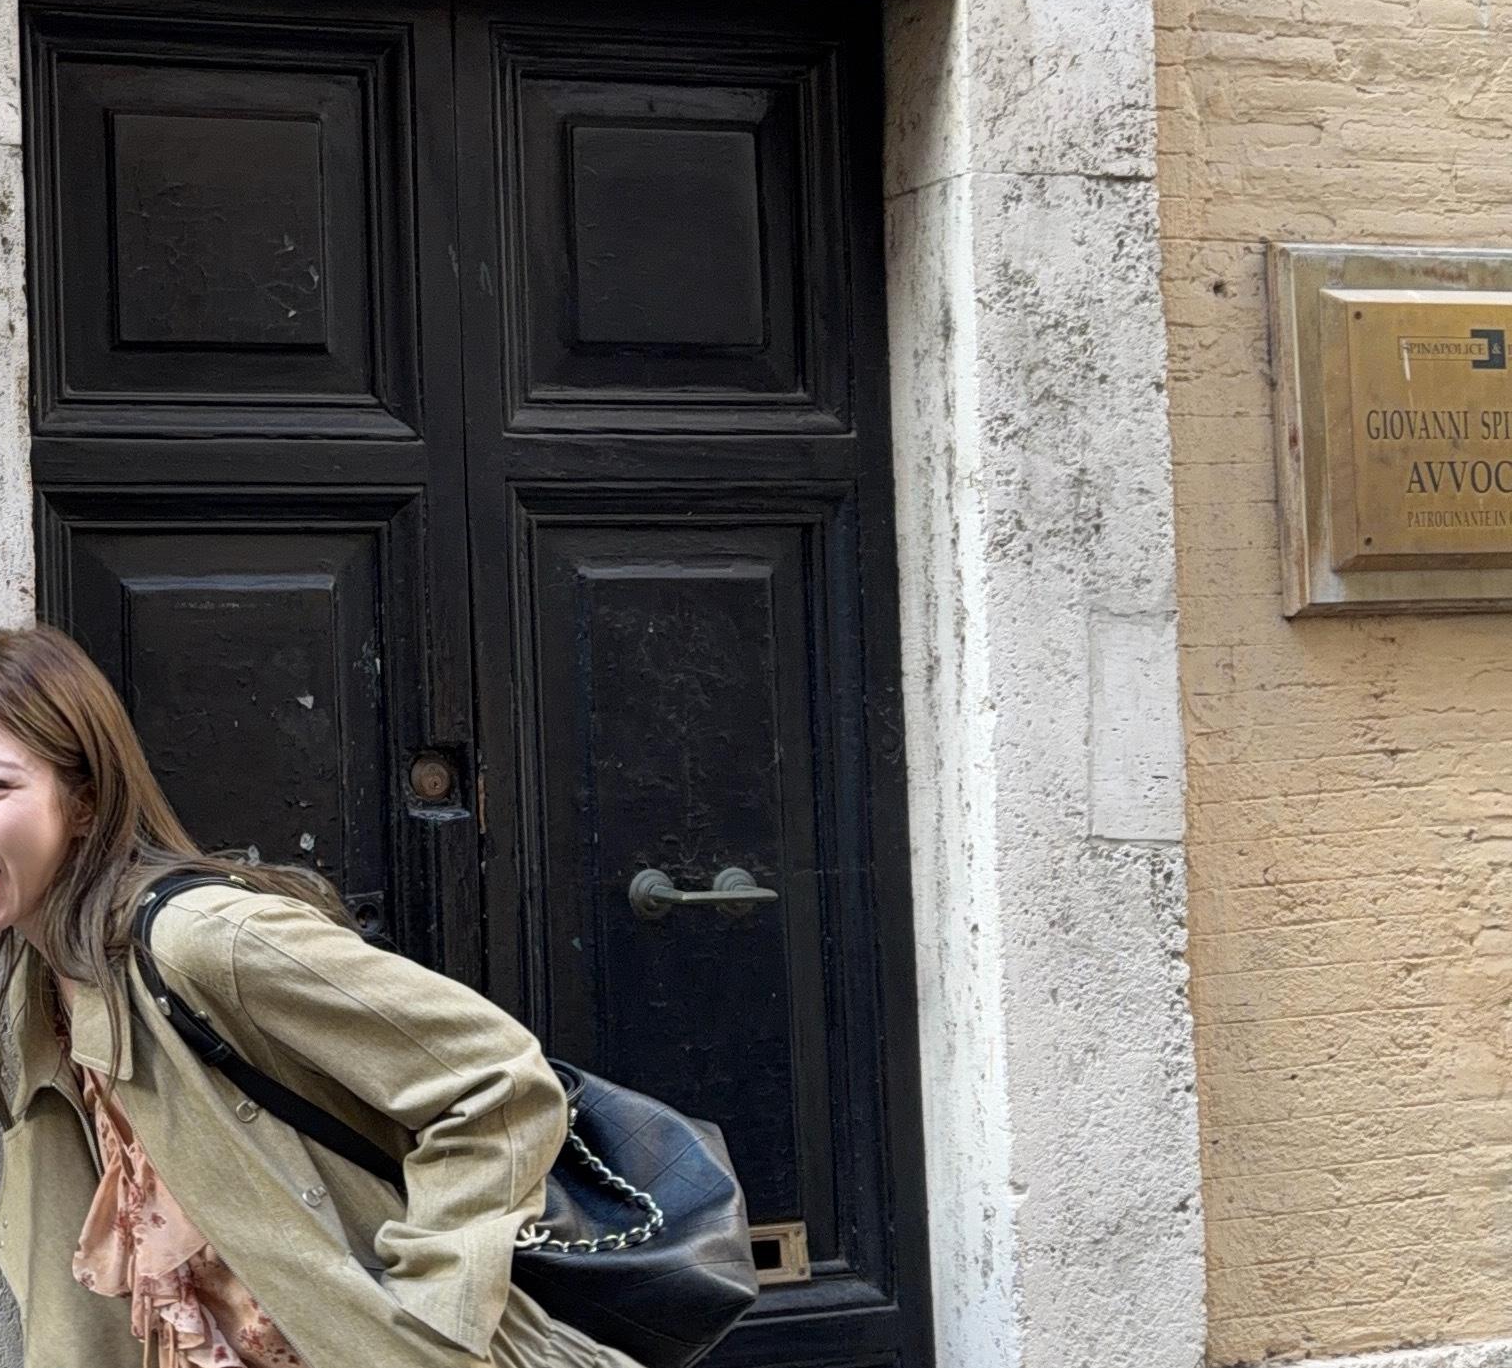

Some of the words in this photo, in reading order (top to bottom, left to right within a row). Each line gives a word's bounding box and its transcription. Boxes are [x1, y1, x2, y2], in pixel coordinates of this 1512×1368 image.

[1491, 342, 1502, 355] &
[1366, 409, 1470, 440] GIOVANNI
[1480, 410, 1512, 440] SPI
[1405, 460, 1512, 494] AVVOC
[1407, 511, 1491, 528] PATROCINANTE
